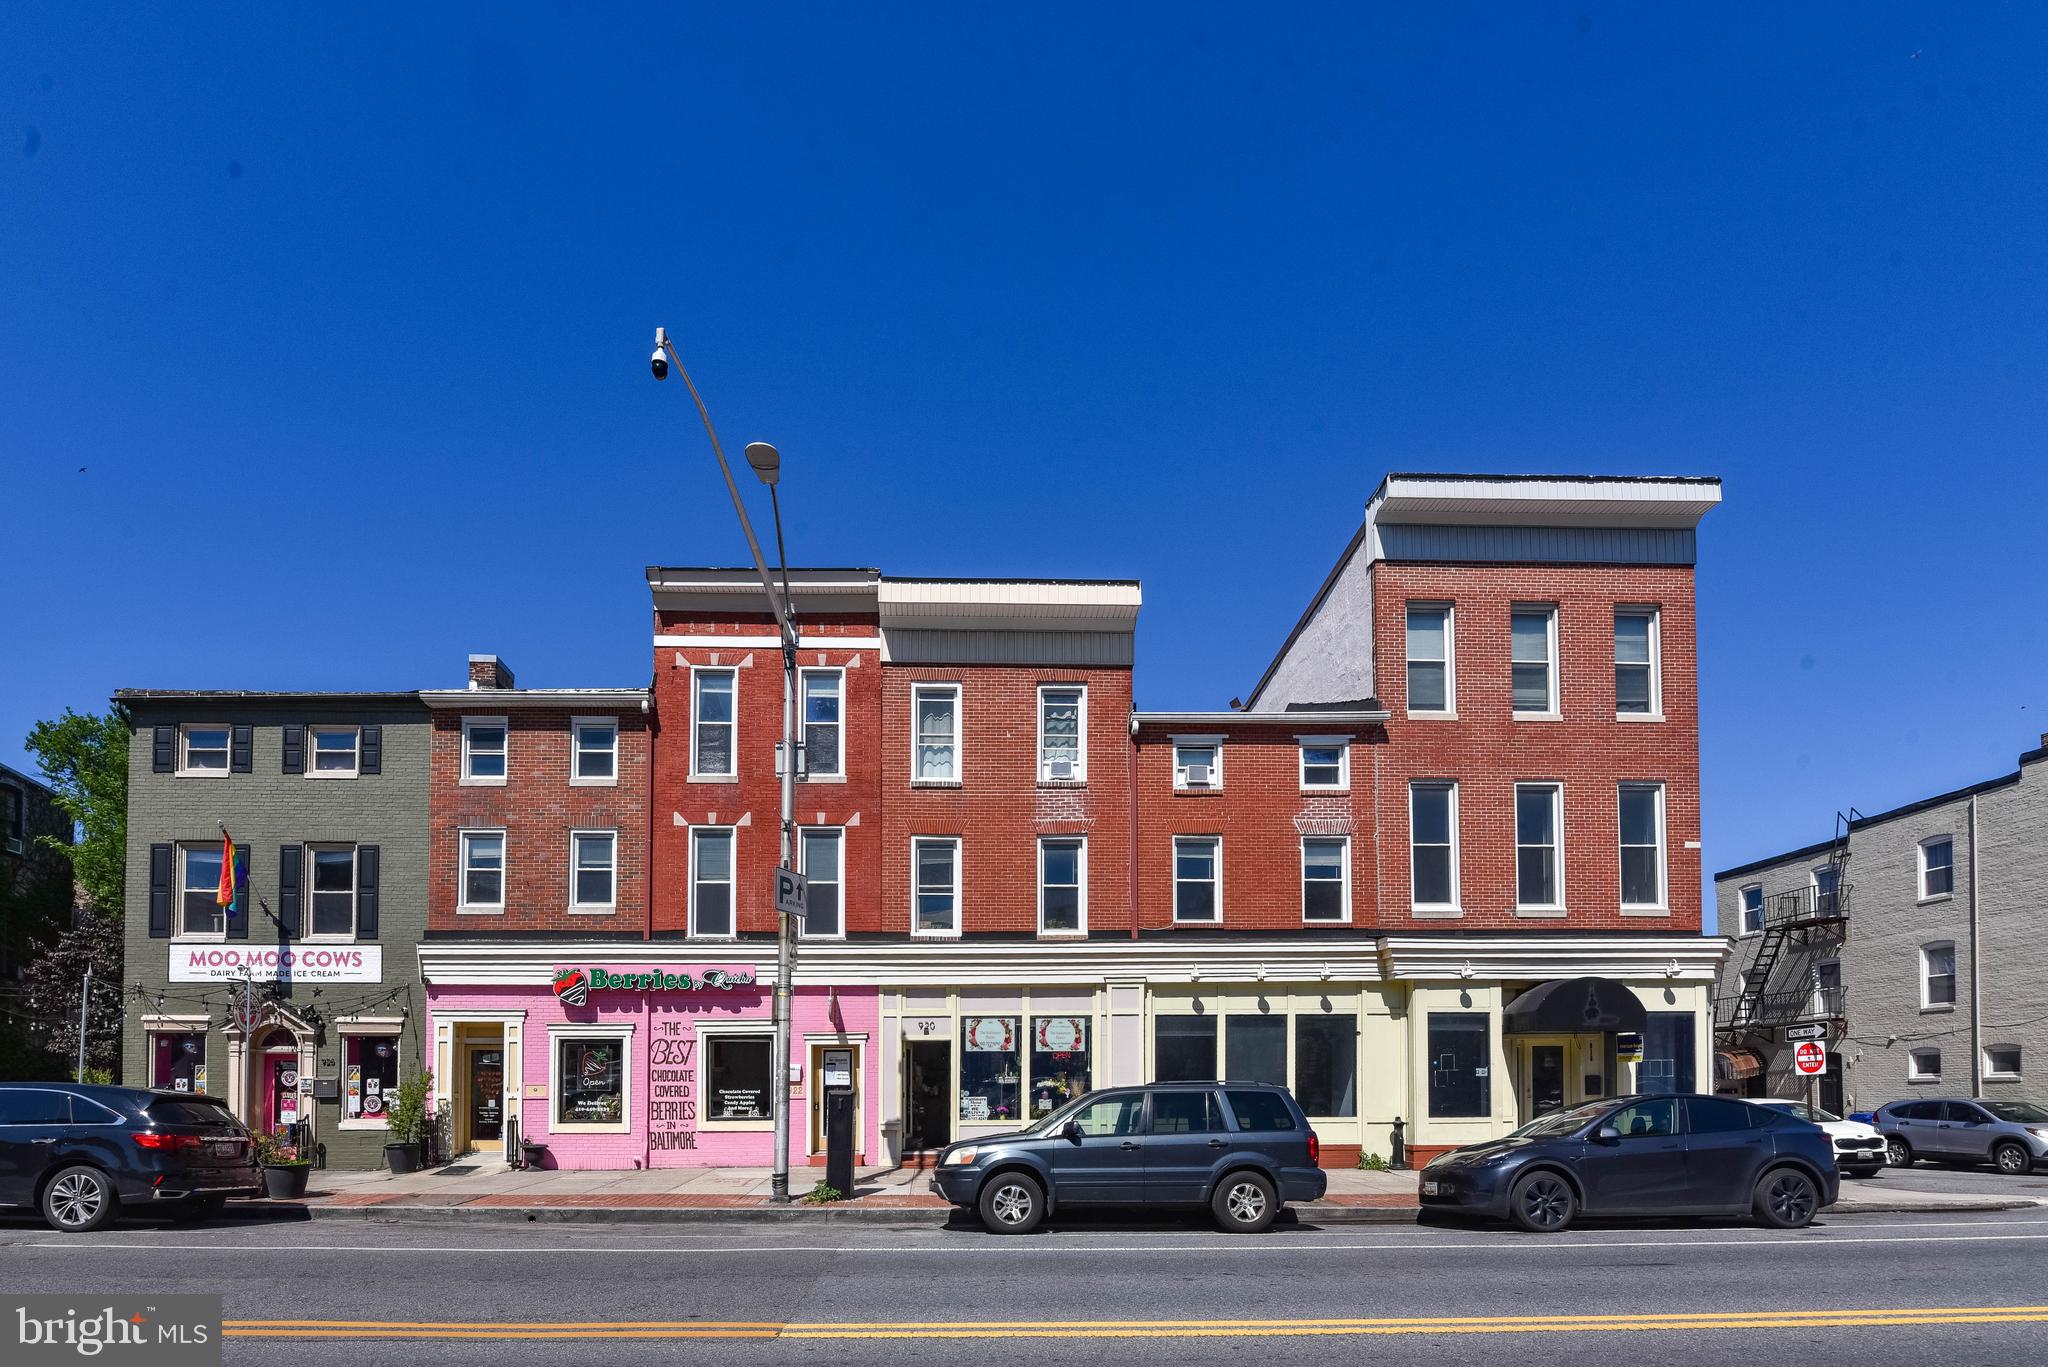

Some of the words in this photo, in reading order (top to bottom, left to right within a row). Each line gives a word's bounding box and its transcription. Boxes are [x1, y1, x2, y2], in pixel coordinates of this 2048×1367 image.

[189, 951, 240, 967] MOO
[246, 951, 296, 967] MOO
[302, 951, 362, 967] COWS
[589, 968, 691, 989] Berries
[662, 1022, 681, 1035] THE
[918, 1021, 935, 1031] 920
[651, 1038, 697, 1065] BEST
[583, 1078, 605, 1088] Open
[651, 1070, 694, 1082] CHOCOLATE
[654, 1085, 689, 1097] COVERED
[651, 1101, 695, 1120] BERRIES
[650, 1131, 698, 1150] BALTIMORE
